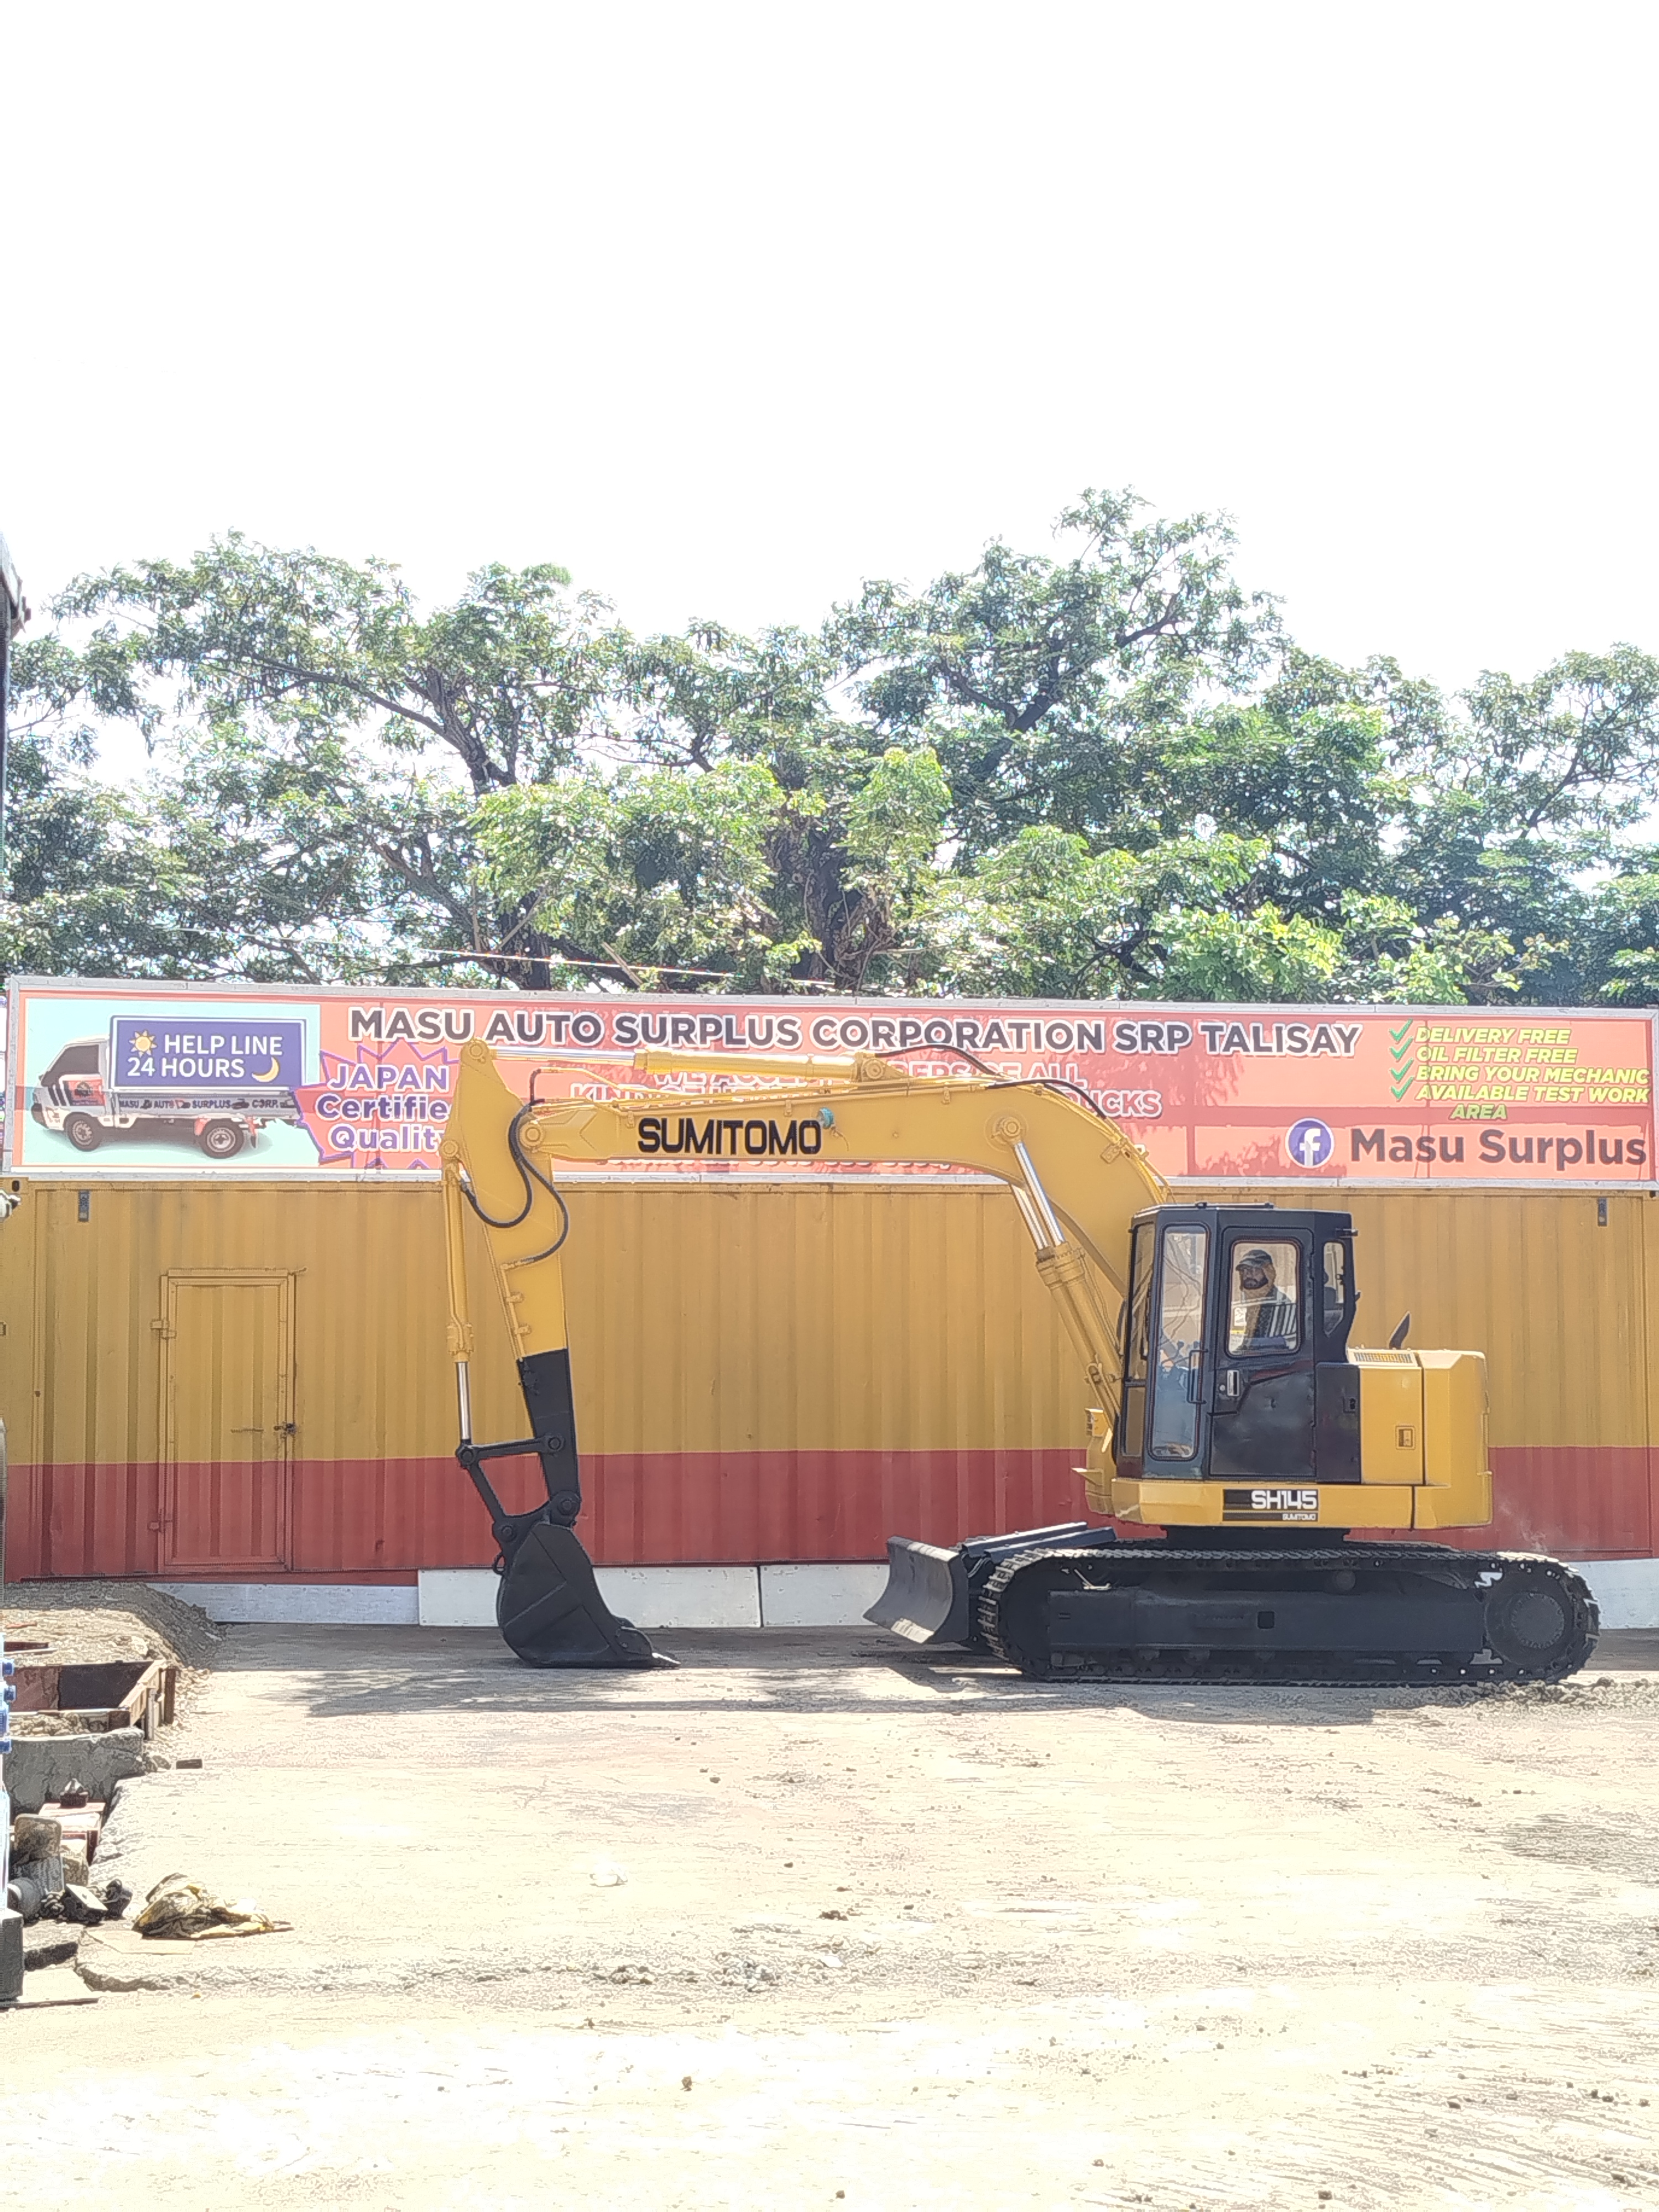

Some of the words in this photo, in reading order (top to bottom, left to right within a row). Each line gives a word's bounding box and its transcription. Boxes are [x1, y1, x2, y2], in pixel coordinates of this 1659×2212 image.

[351, 1009, 472, 1041] MASU
[487, 1013, 602, 1044] AUTO
[615, 1015, 799, 1047] SURPLUS
[813, 1019, 1103, 1050] CORPORATION
[1115, 1023, 1189, 1051] SRP
[1201, 1025, 1360, 1053] TALISAY
[1416, 1027, 1515, 1044] DELIVERY
[1519, 1029, 1571, 1045] FREE
[165, 1035, 225, 1055] HELP
[231, 1036, 283, 1056] LINE
[1417, 1046, 1448, 1062] OIL
[1453, 1048, 1520, 1063] FILTER
[1526, 1048, 1578, 1063] FREE
[127, 1057, 155, 1077] 24
[161, 1058, 244, 1078] HOURS
[331, 1065, 447, 1089] JAPAN
[1416, 1066, 1479, 1082] BRING
[1485, 1067, 1540, 1083] YOUR
[1543, 1067, 1650, 1084] MECHANIC
[192, 1099, 231, 1109] SURPLUS
[1416, 1085, 1528, 1102] AVAILABLE
[1534, 1086, 1584, 1102] TEST
[1589, 1087, 1650, 1103] WORK
[317, 1094, 449, 1119] Certifie
[1450, 1104, 1507, 1119] AREA
[330, 1126, 445, 1150] Qualit
[638, 1117, 822, 1155] SUMITOMO
[1351, 1128, 1464, 1162] Masu
[1479, 1129, 1646, 1171] Surplus
[1251, 1490, 1317, 1510] SH145
